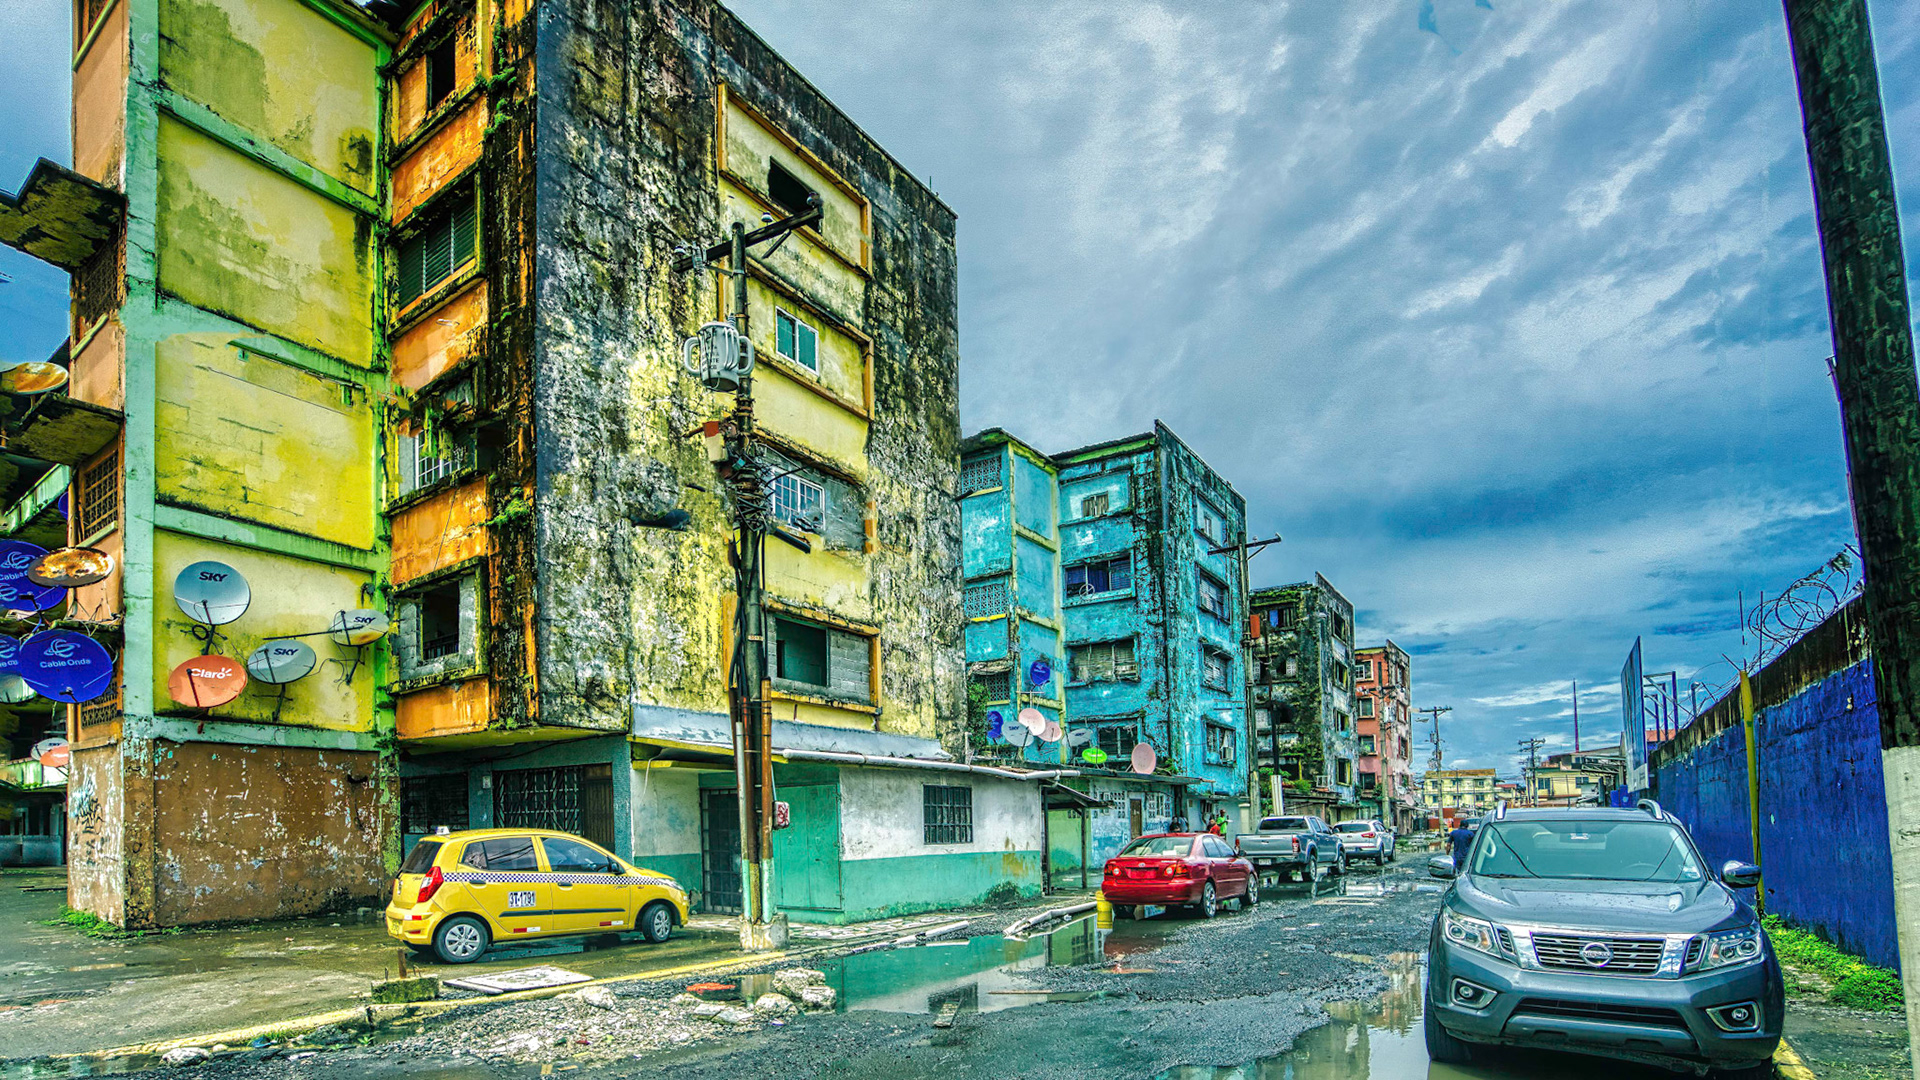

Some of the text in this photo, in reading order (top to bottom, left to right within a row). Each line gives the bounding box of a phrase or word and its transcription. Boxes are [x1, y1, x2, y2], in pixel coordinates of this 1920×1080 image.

[199, 571, 228, 582] SKY
[354, 616, 376, 624] SKY
[273, 647, 299, 656] SKY
[39, 658, 92, 669] Cable Onda
[190, 668, 228, 679] Claro
